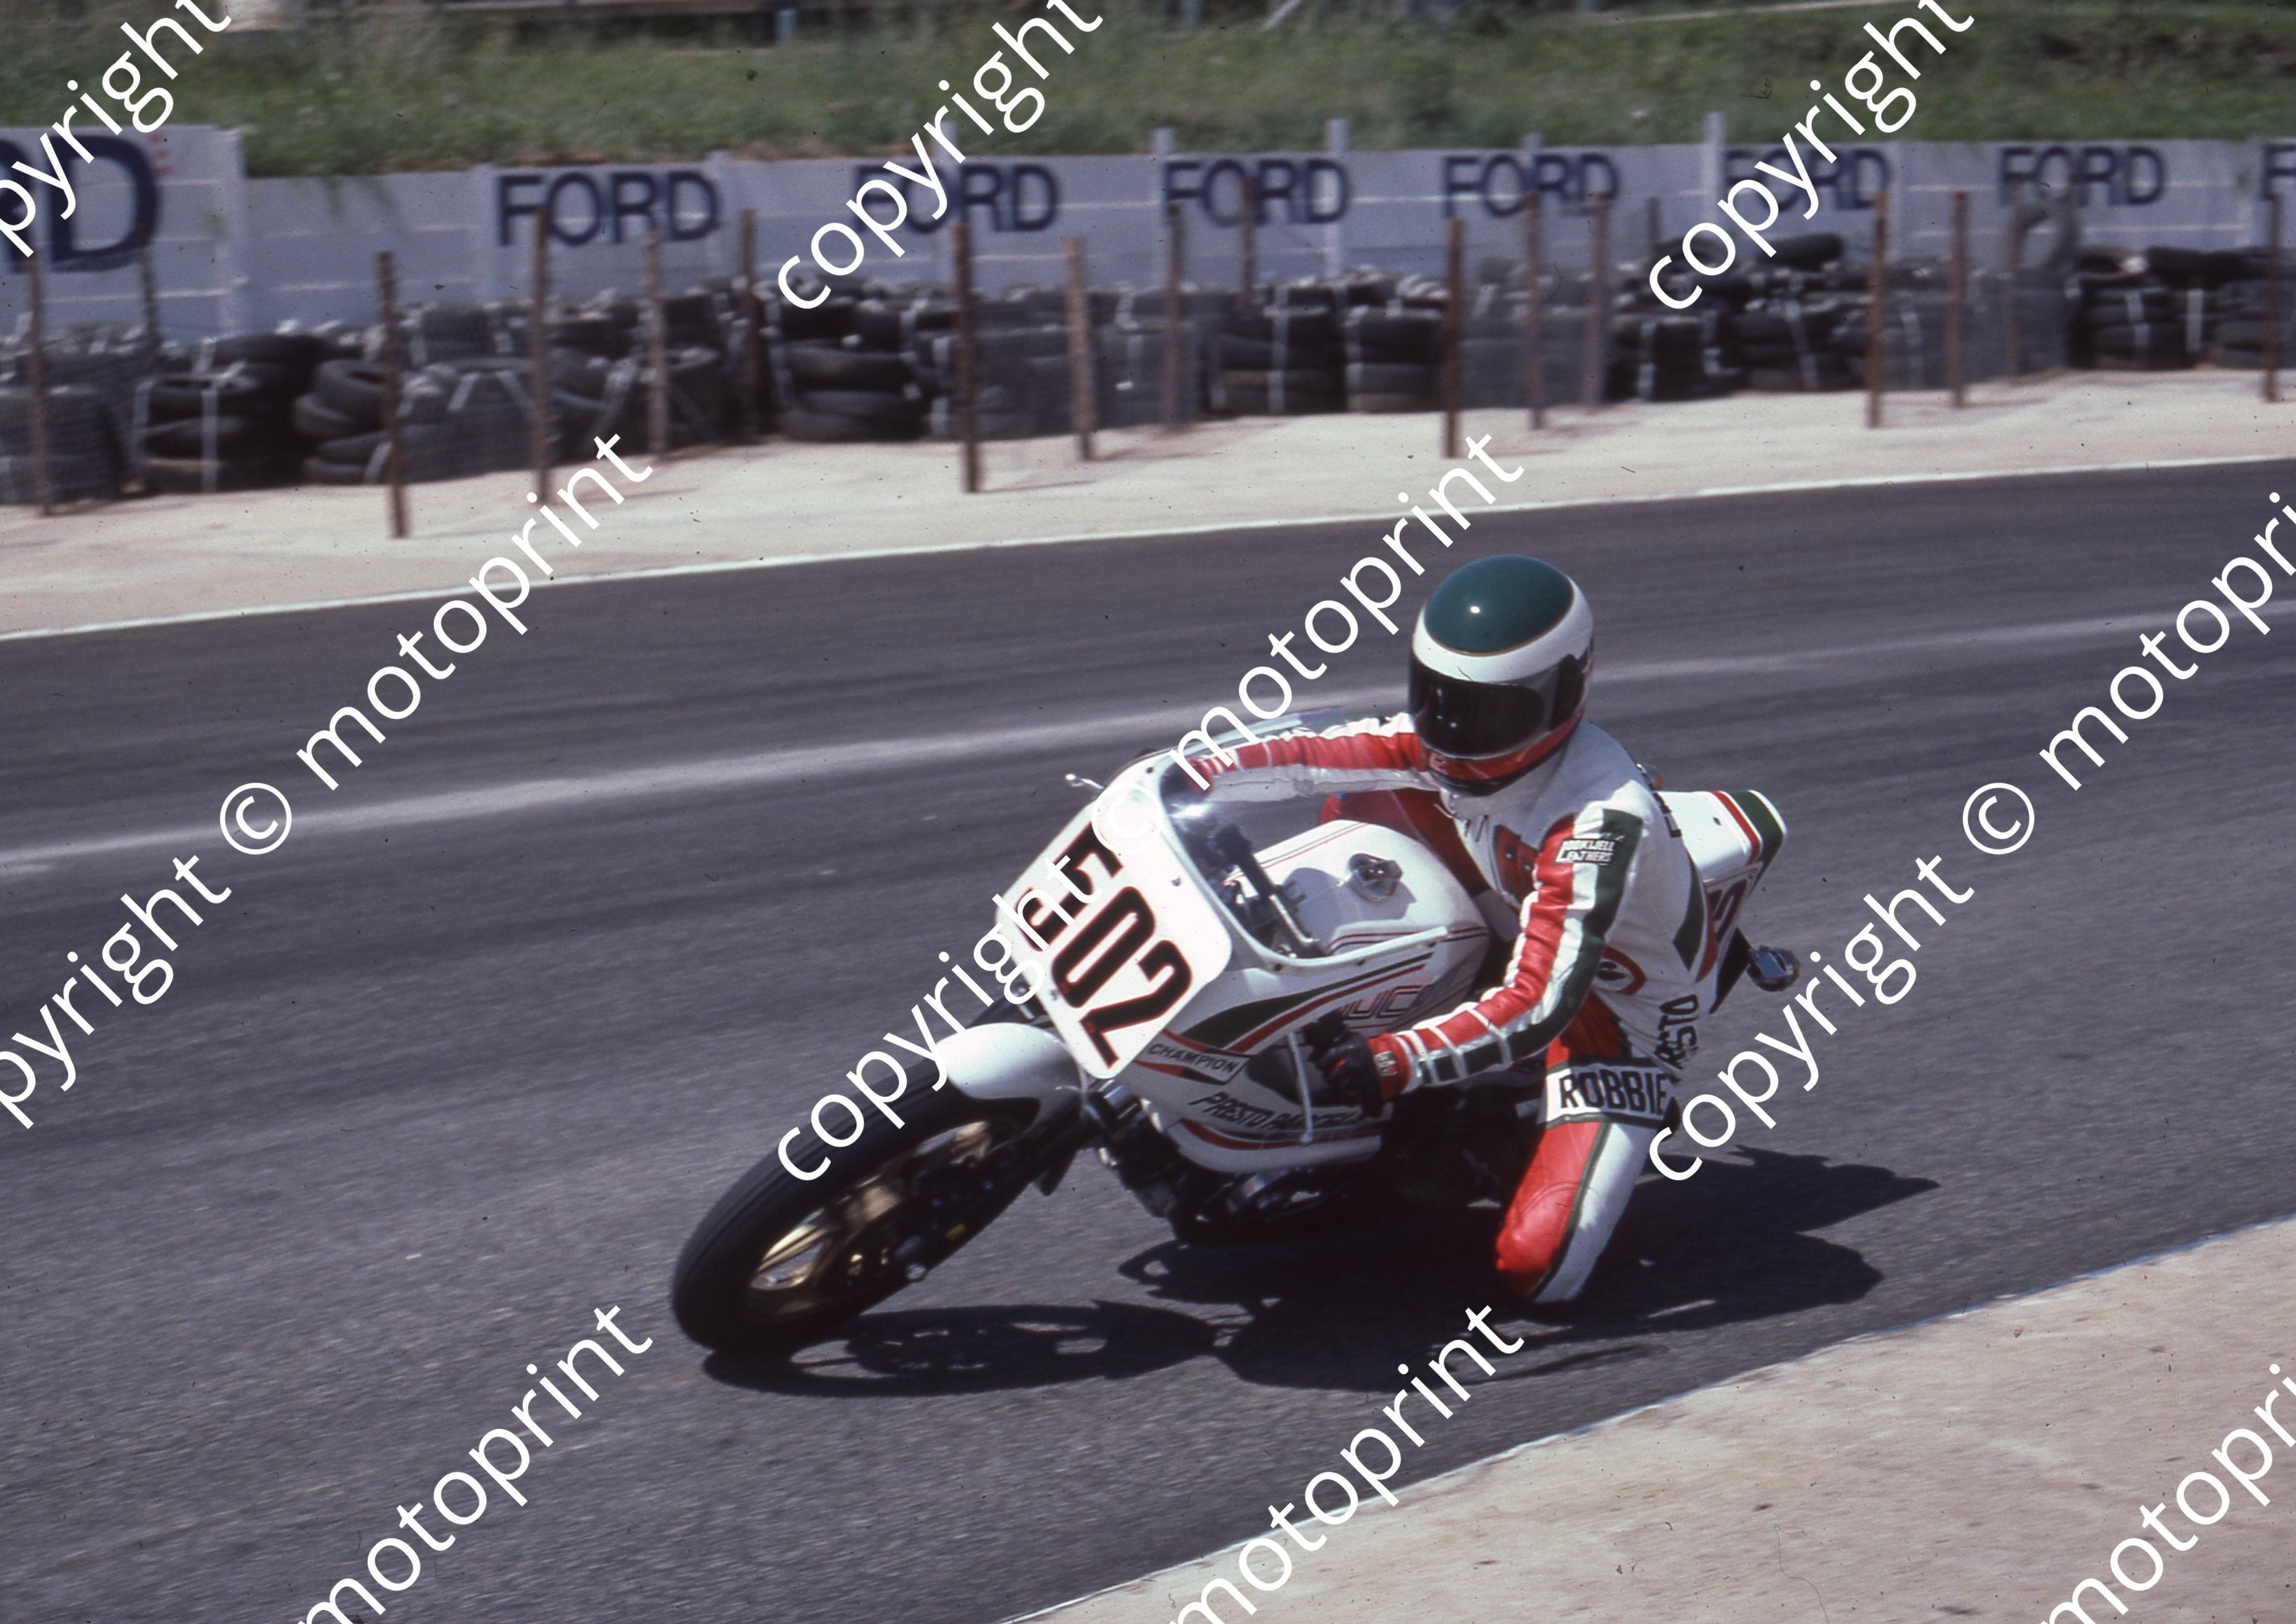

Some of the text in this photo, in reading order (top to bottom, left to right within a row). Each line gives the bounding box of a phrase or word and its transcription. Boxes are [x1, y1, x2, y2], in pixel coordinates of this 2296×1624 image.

[854, 164, 1058, 235] FORD
[1164, 158, 1351, 227] FORD
[1444, 153, 1619, 217] FORD
[2000, 146, 2166, 206] FORD
[498, 172, 721, 247] FORD
[1015, 820, 1193, 1069] 502
[1148, 1043, 1239, 1073] CHAMPION
[1559, 1068, 1671, 1114] ROBBIE
